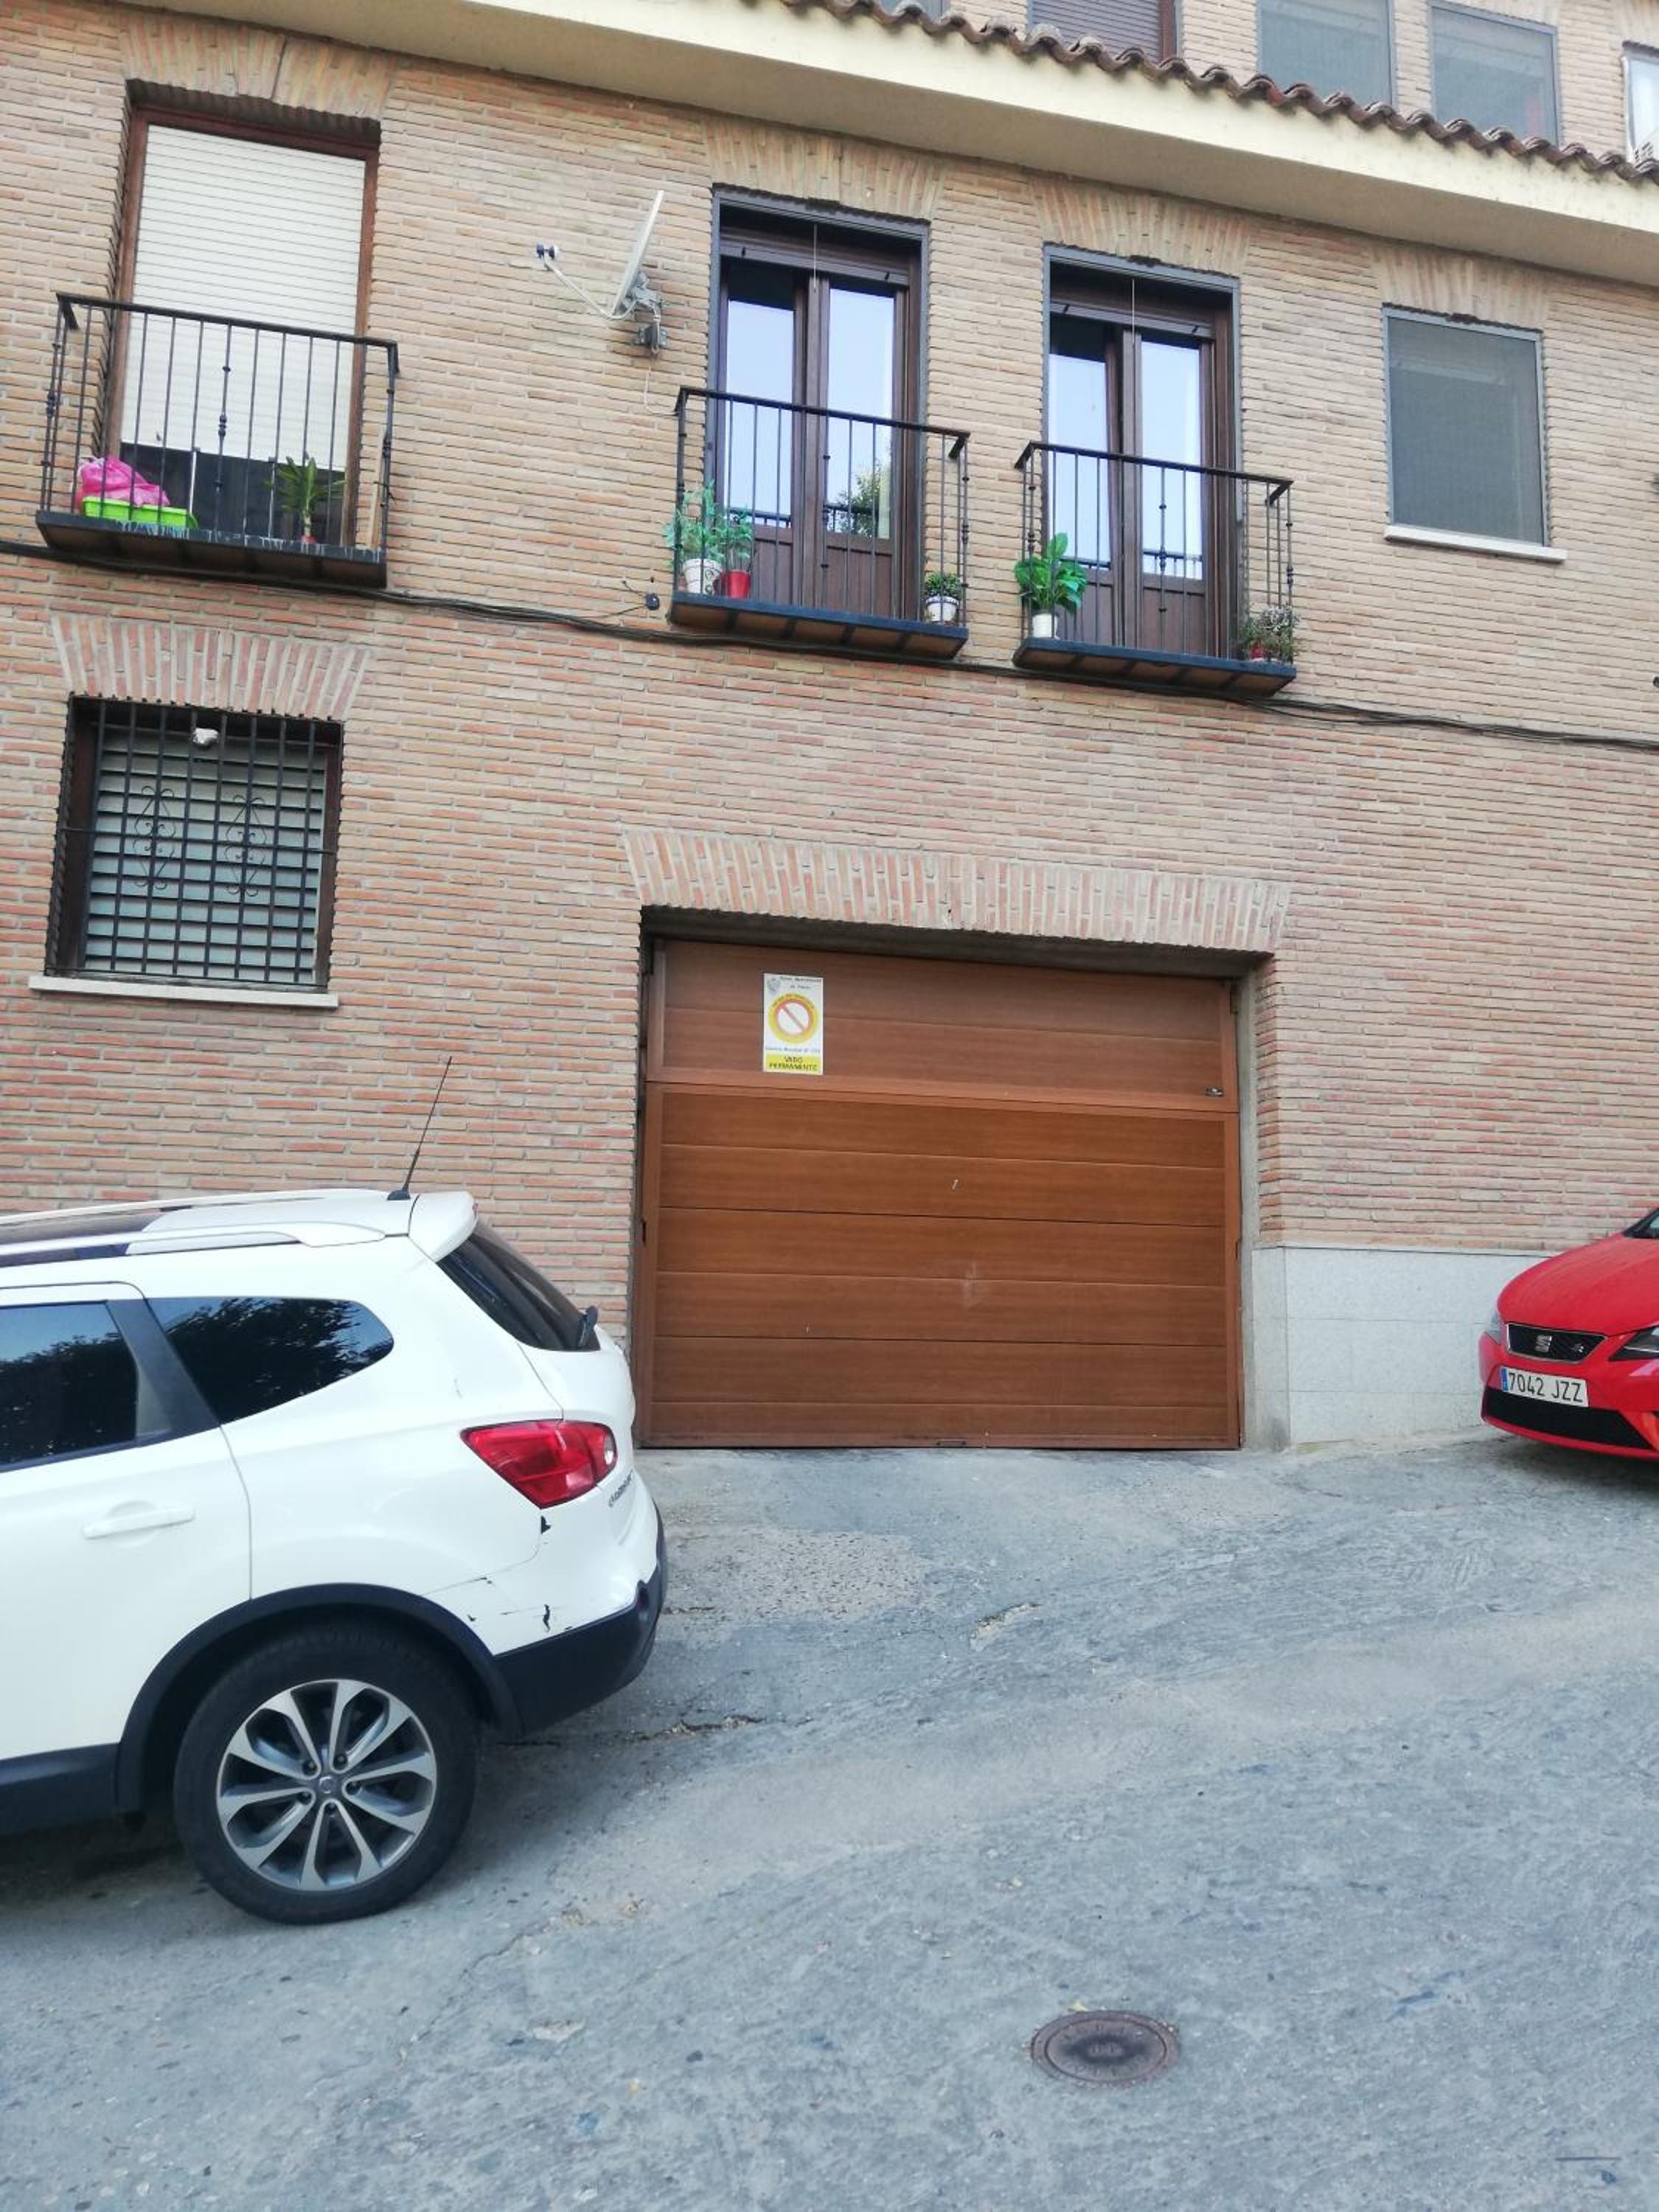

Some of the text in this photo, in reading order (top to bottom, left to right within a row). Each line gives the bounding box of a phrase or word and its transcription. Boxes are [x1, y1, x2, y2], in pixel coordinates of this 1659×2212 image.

[769, 1062, 818, 1071] PERMANENTE
[1509, 1372, 1583, 1402] 7042 JZZ
